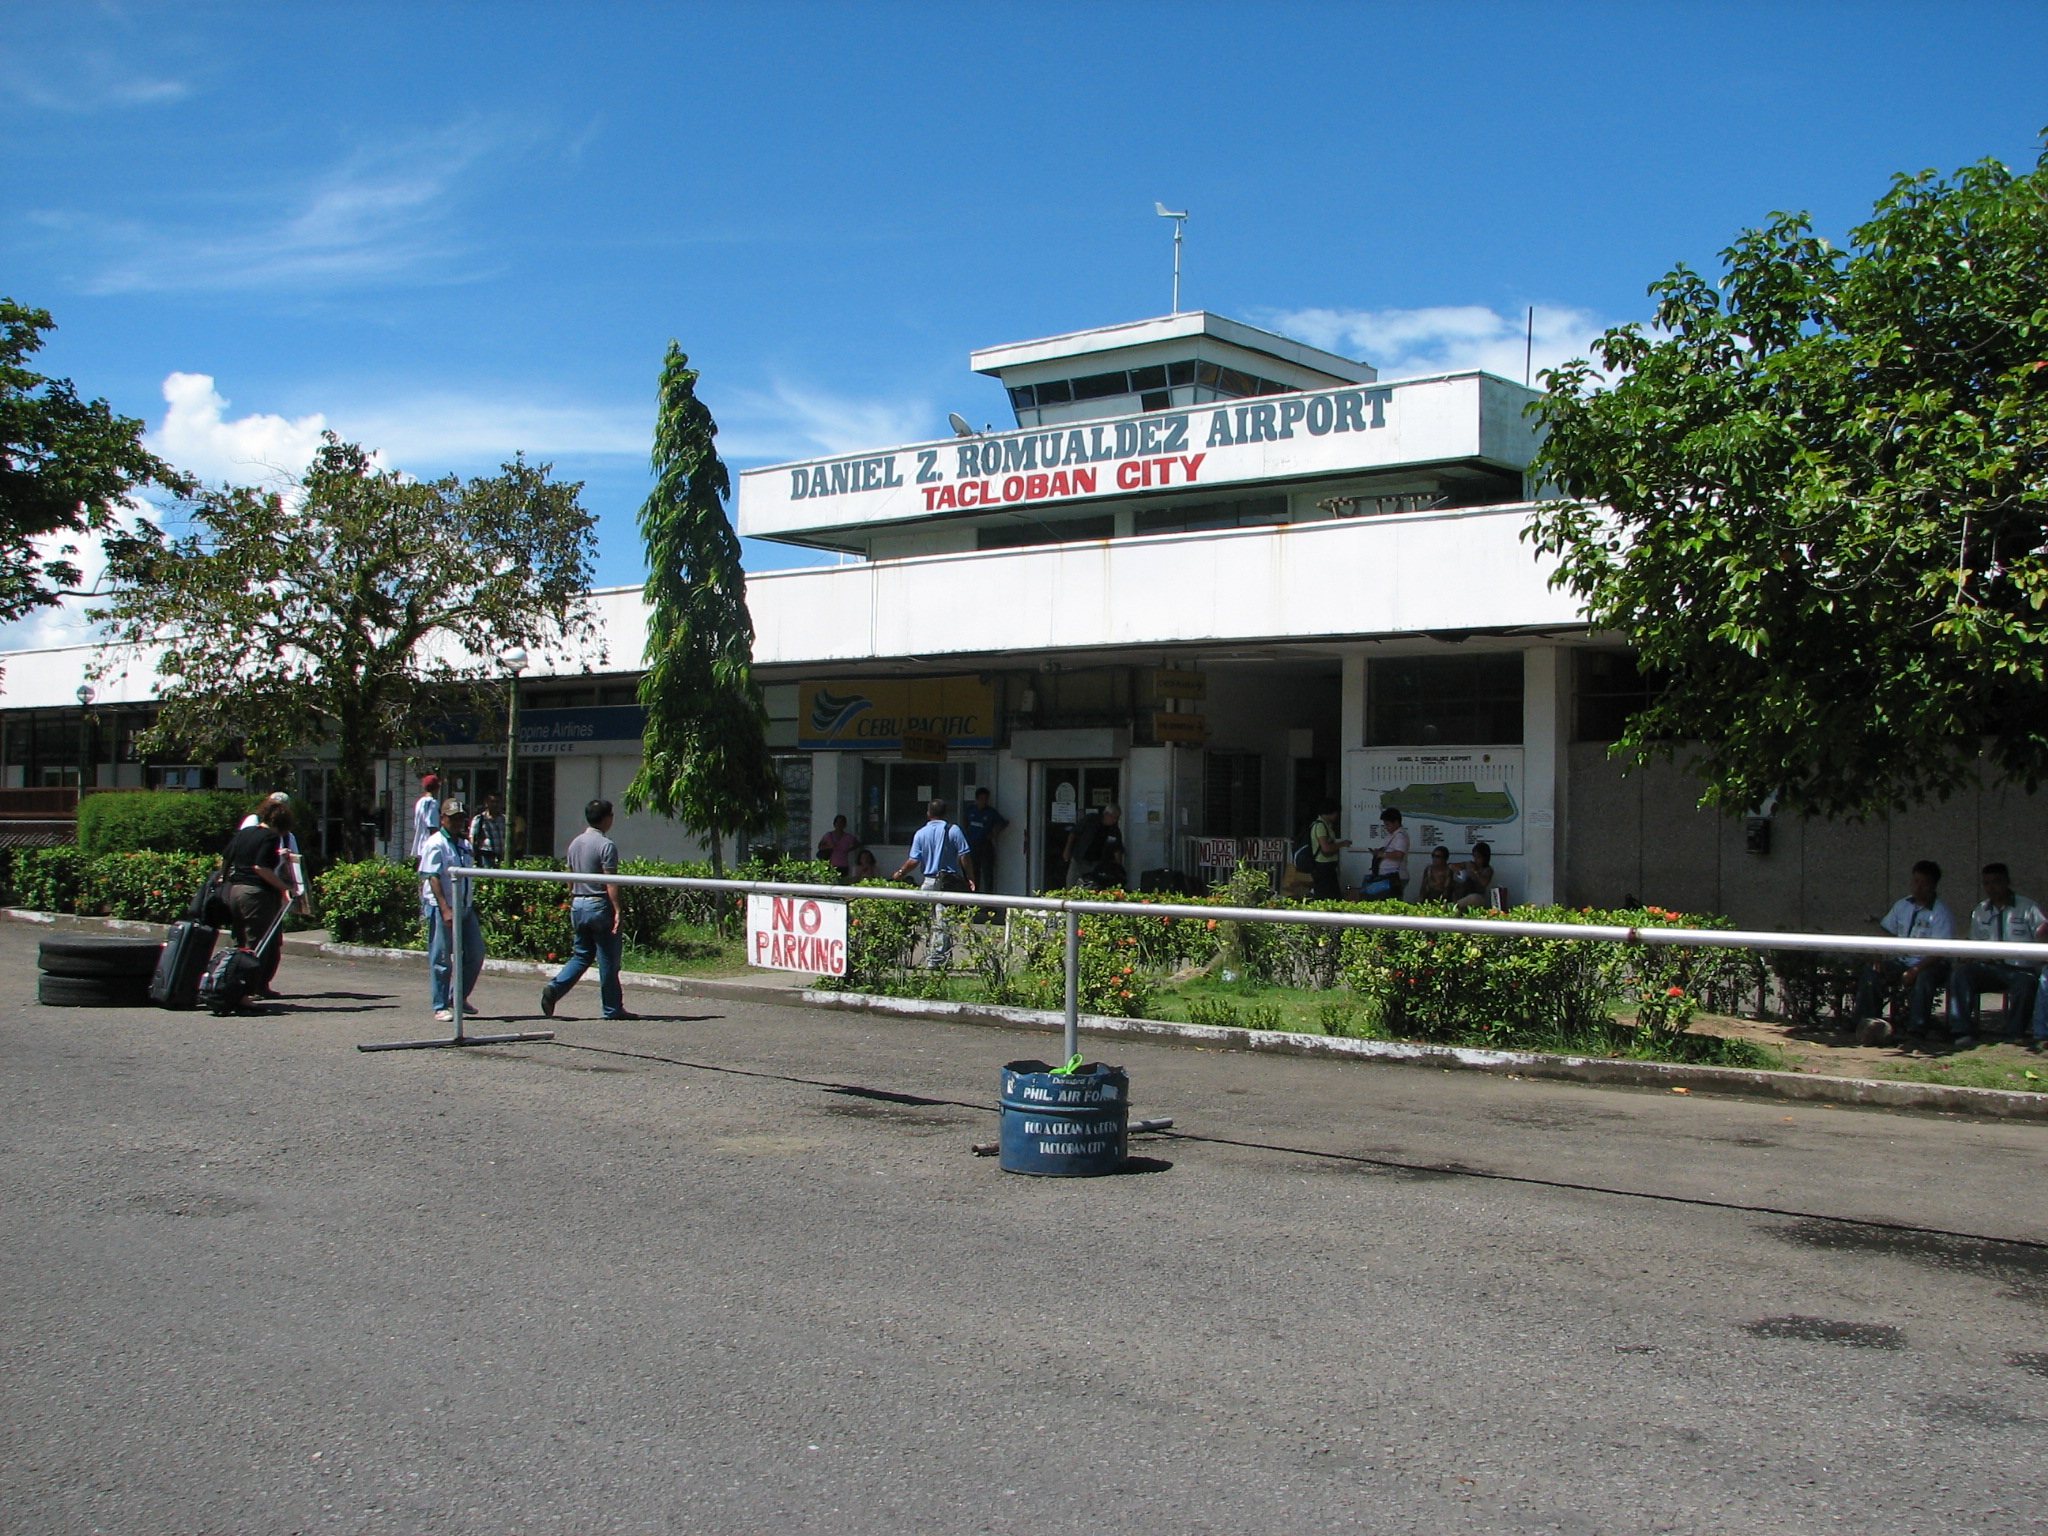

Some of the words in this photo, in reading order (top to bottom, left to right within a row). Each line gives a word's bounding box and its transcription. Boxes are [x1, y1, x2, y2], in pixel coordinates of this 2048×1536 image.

[791, 456, 904, 501] DANIEL
[916, 450, 943, 484] Z.
[957, 415, 1189, 478] ROMUALDEZ
[1206, 389, 1392, 447] AIRPORT
[922, 467, 1097, 511] TACLOBAN
[1117, 453, 1206, 489] CITY
[552, 722, 593, 737] Airlines
[857, 718, 902, 737] CEBU
[907, 715, 978, 735] PACIFIC
[489, 745, 528, 753] TICET
[533, 743, 574, 753] OFFICE
[1200, 842, 1211, 862] NO
[1212, 840, 1235, 854] TICKET
[1244, 839, 1259, 860] NO
[1212, 854, 1235, 866] ENTRY
[772, 896, 821, 935] NO
[756, 931, 843, 974] PARKING
[1024, 1088, 1053, 1100] PHIL.
[1058, 1090, 1080, 1102] AIR
[1024, 1121, 1042, 1134] FOR
[1044, 1122, 1051, 1135] A
[1052, 1123, 1083, 1135] CLEAN
[1039, 1141, 1086, 1154] TACLOBAN
